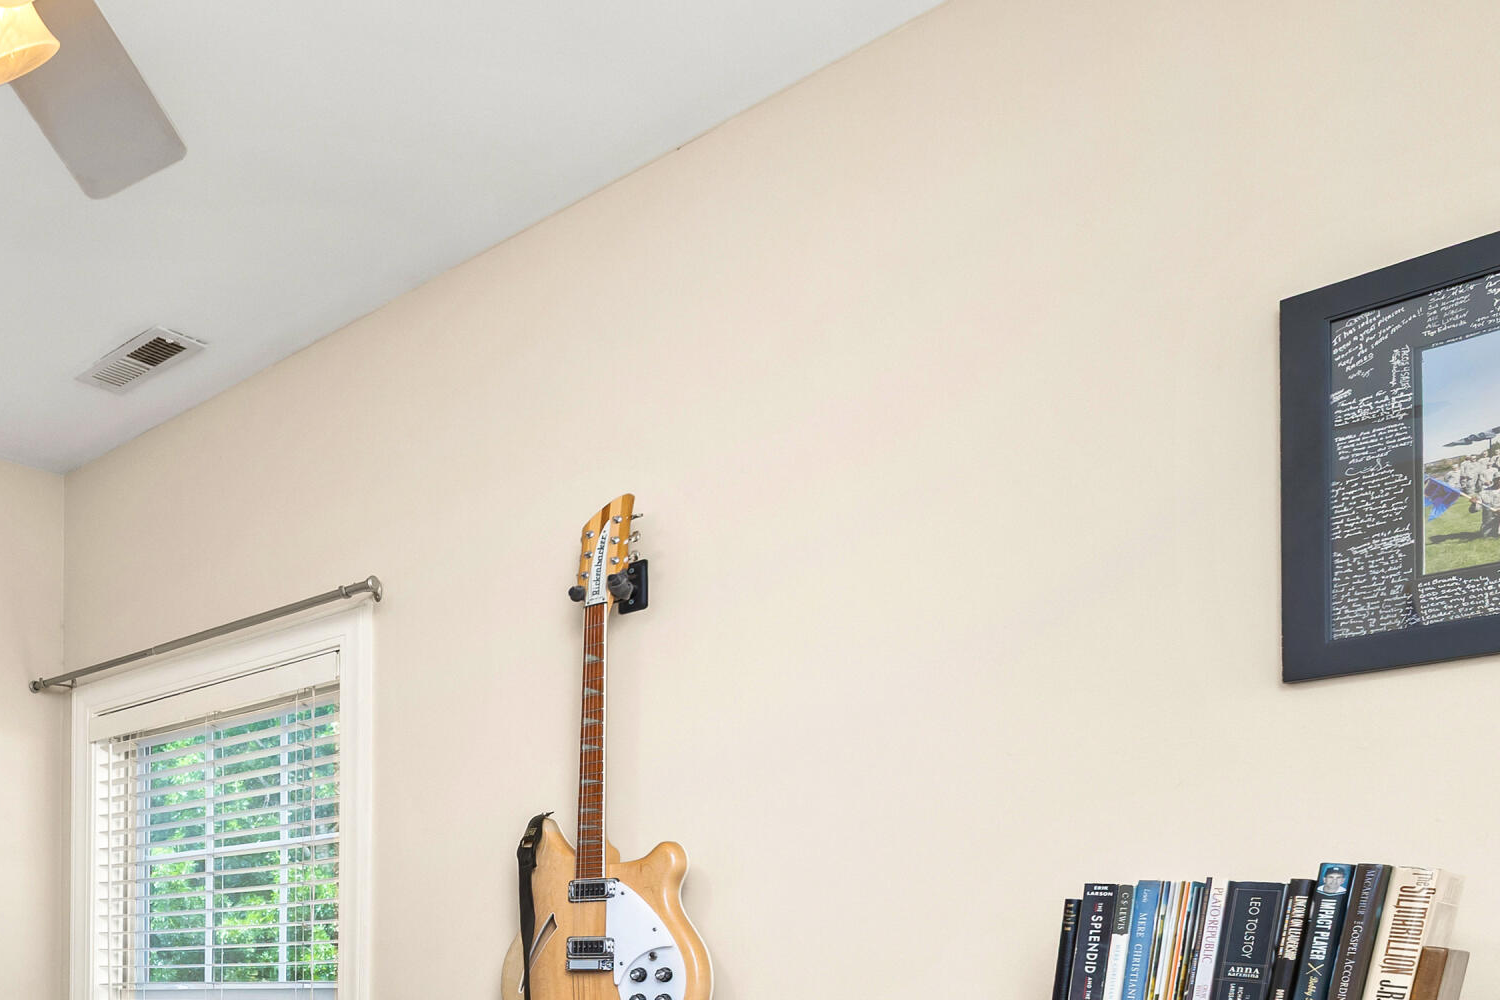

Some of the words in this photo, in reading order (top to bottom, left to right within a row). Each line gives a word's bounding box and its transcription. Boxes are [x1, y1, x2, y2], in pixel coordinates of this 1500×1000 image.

[1117, 907, 1129, 930] LEWIS
[1248, 897, 1262, 916] LEO
[1291, 895, 1309, 918] LINCOLN
[1316, 899, 1337, 930] IMPACT
[1136, 913, 1148, 938] MERE
[1290, 919, 1304, 928] ON
[1380, 885, 1436, 976] SILMARILLION
[1085, 915, 1103, 974] SPLENDID
[1241, 919, 1259, 959] TOLSTOY
[1283, 928, 1303, 961] LEADERSHIP
[1309, 931, 1331, 961] PLAYER
[1347, 925, 1363, 956] GOSPEL
[1304, 976, 1319, 997] Bobby
